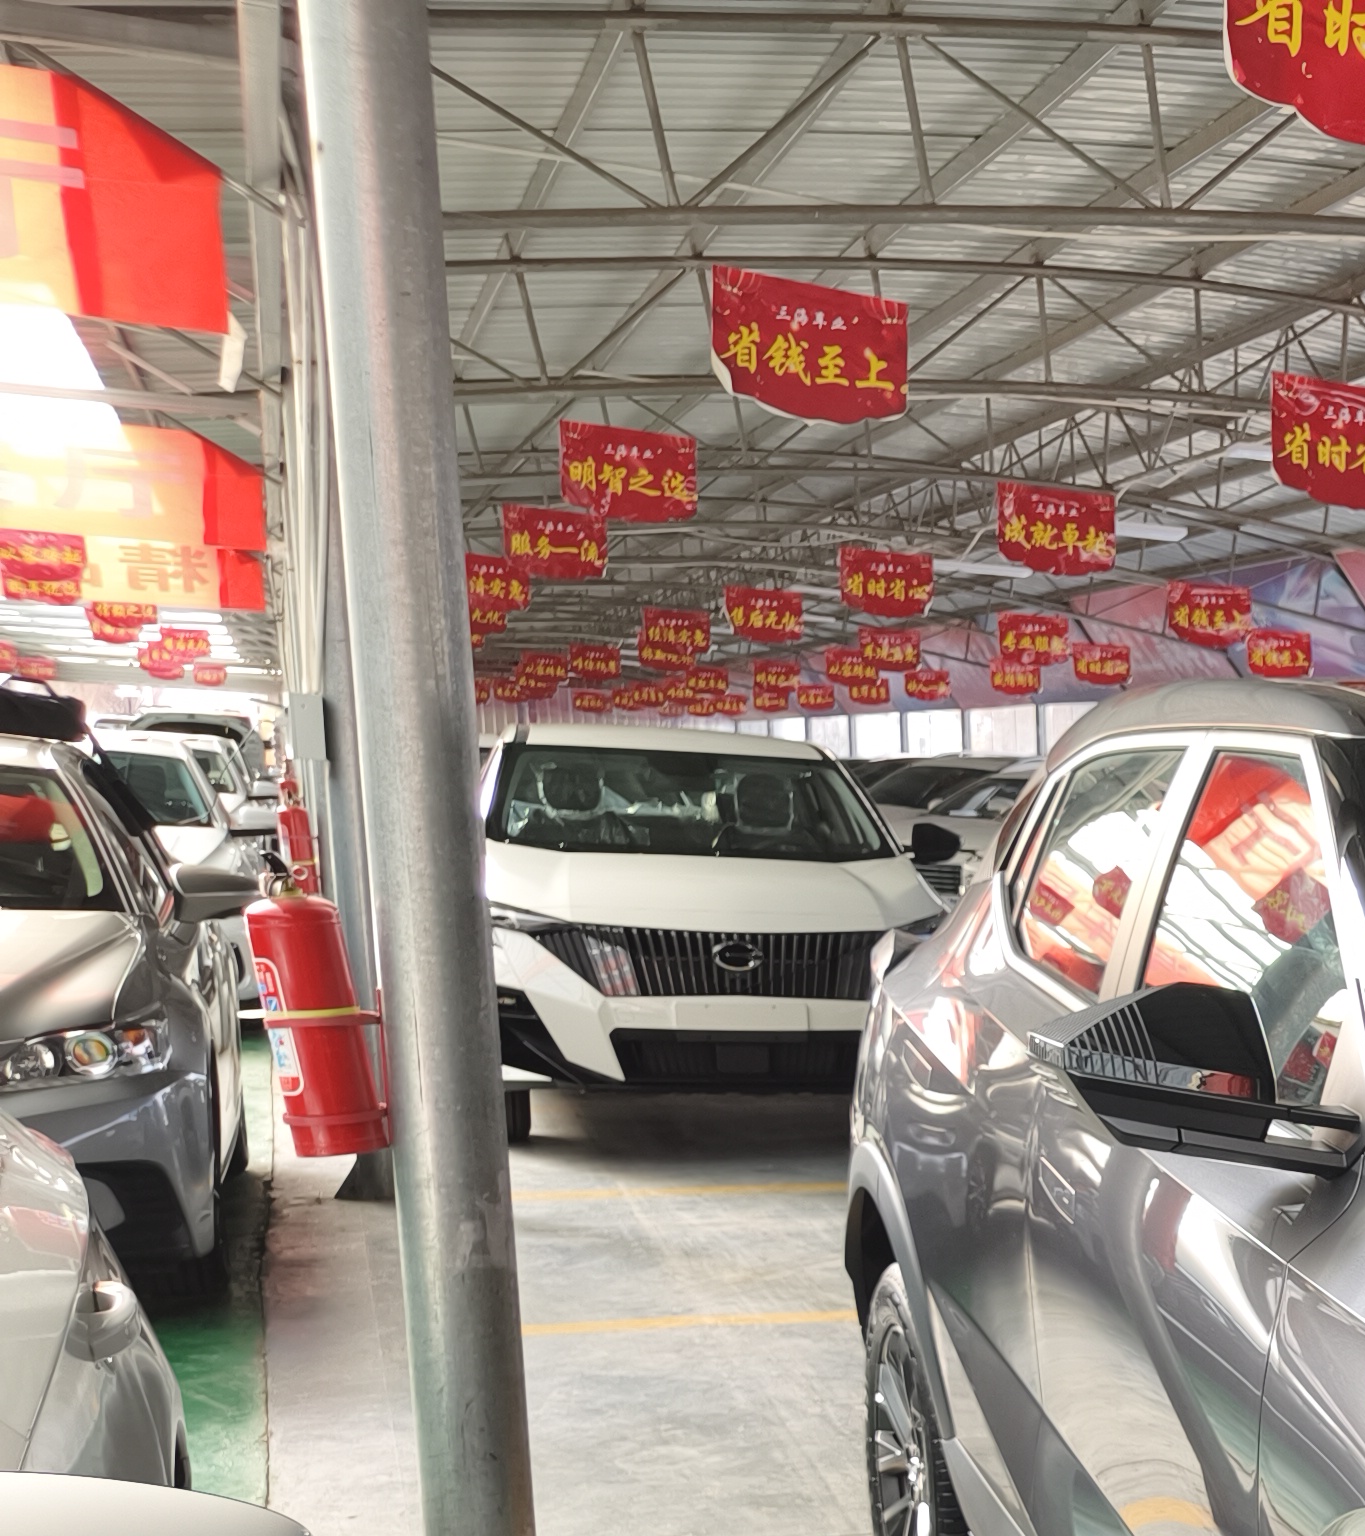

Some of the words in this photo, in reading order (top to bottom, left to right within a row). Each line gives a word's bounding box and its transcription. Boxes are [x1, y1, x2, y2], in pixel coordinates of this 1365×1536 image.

[720, 322, 895, 392] 省钱至上
[569, 456, 688, 501] 明智之选
[1004, 514, 1114, 556] 成就卓越
[843, 572, 931, 602] 省时省心
